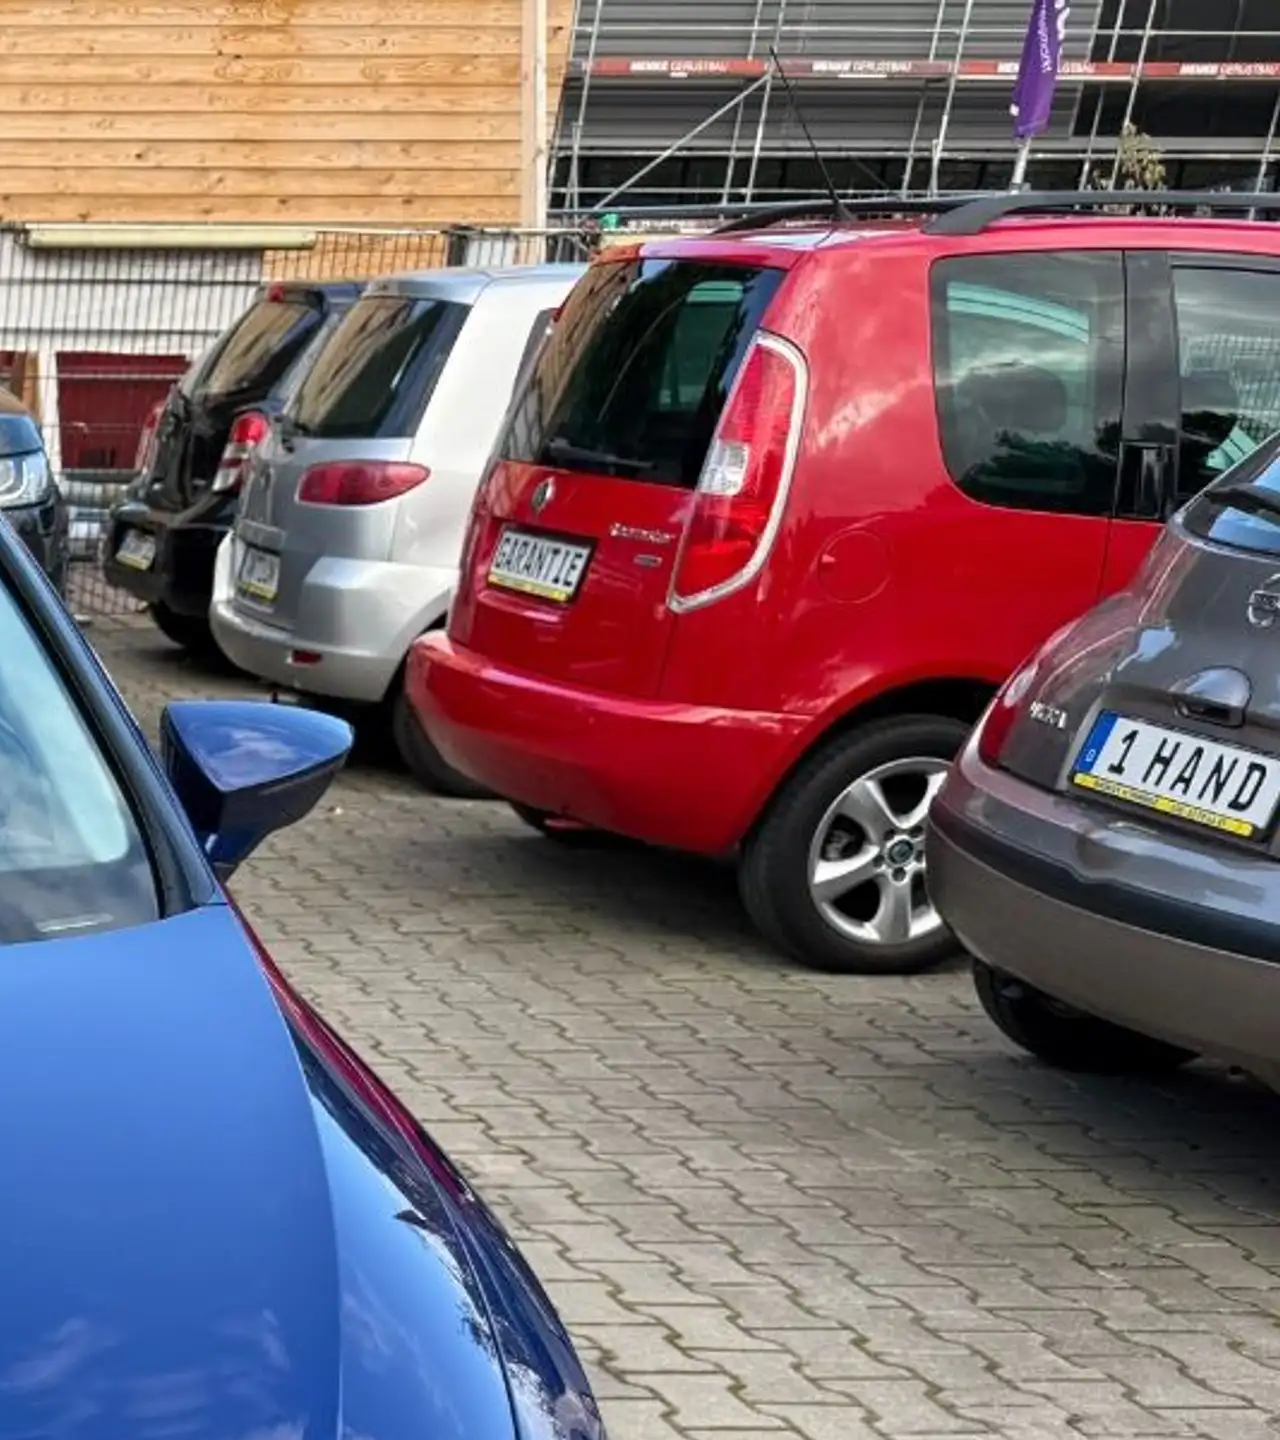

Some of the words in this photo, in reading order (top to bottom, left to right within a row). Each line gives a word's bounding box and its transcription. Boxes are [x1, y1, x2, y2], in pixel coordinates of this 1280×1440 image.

[493, 535, 585, 588] GARANTIE
[1107, 729, 1140, 776] 1
[1141, 737, 1268, 813] HAND
